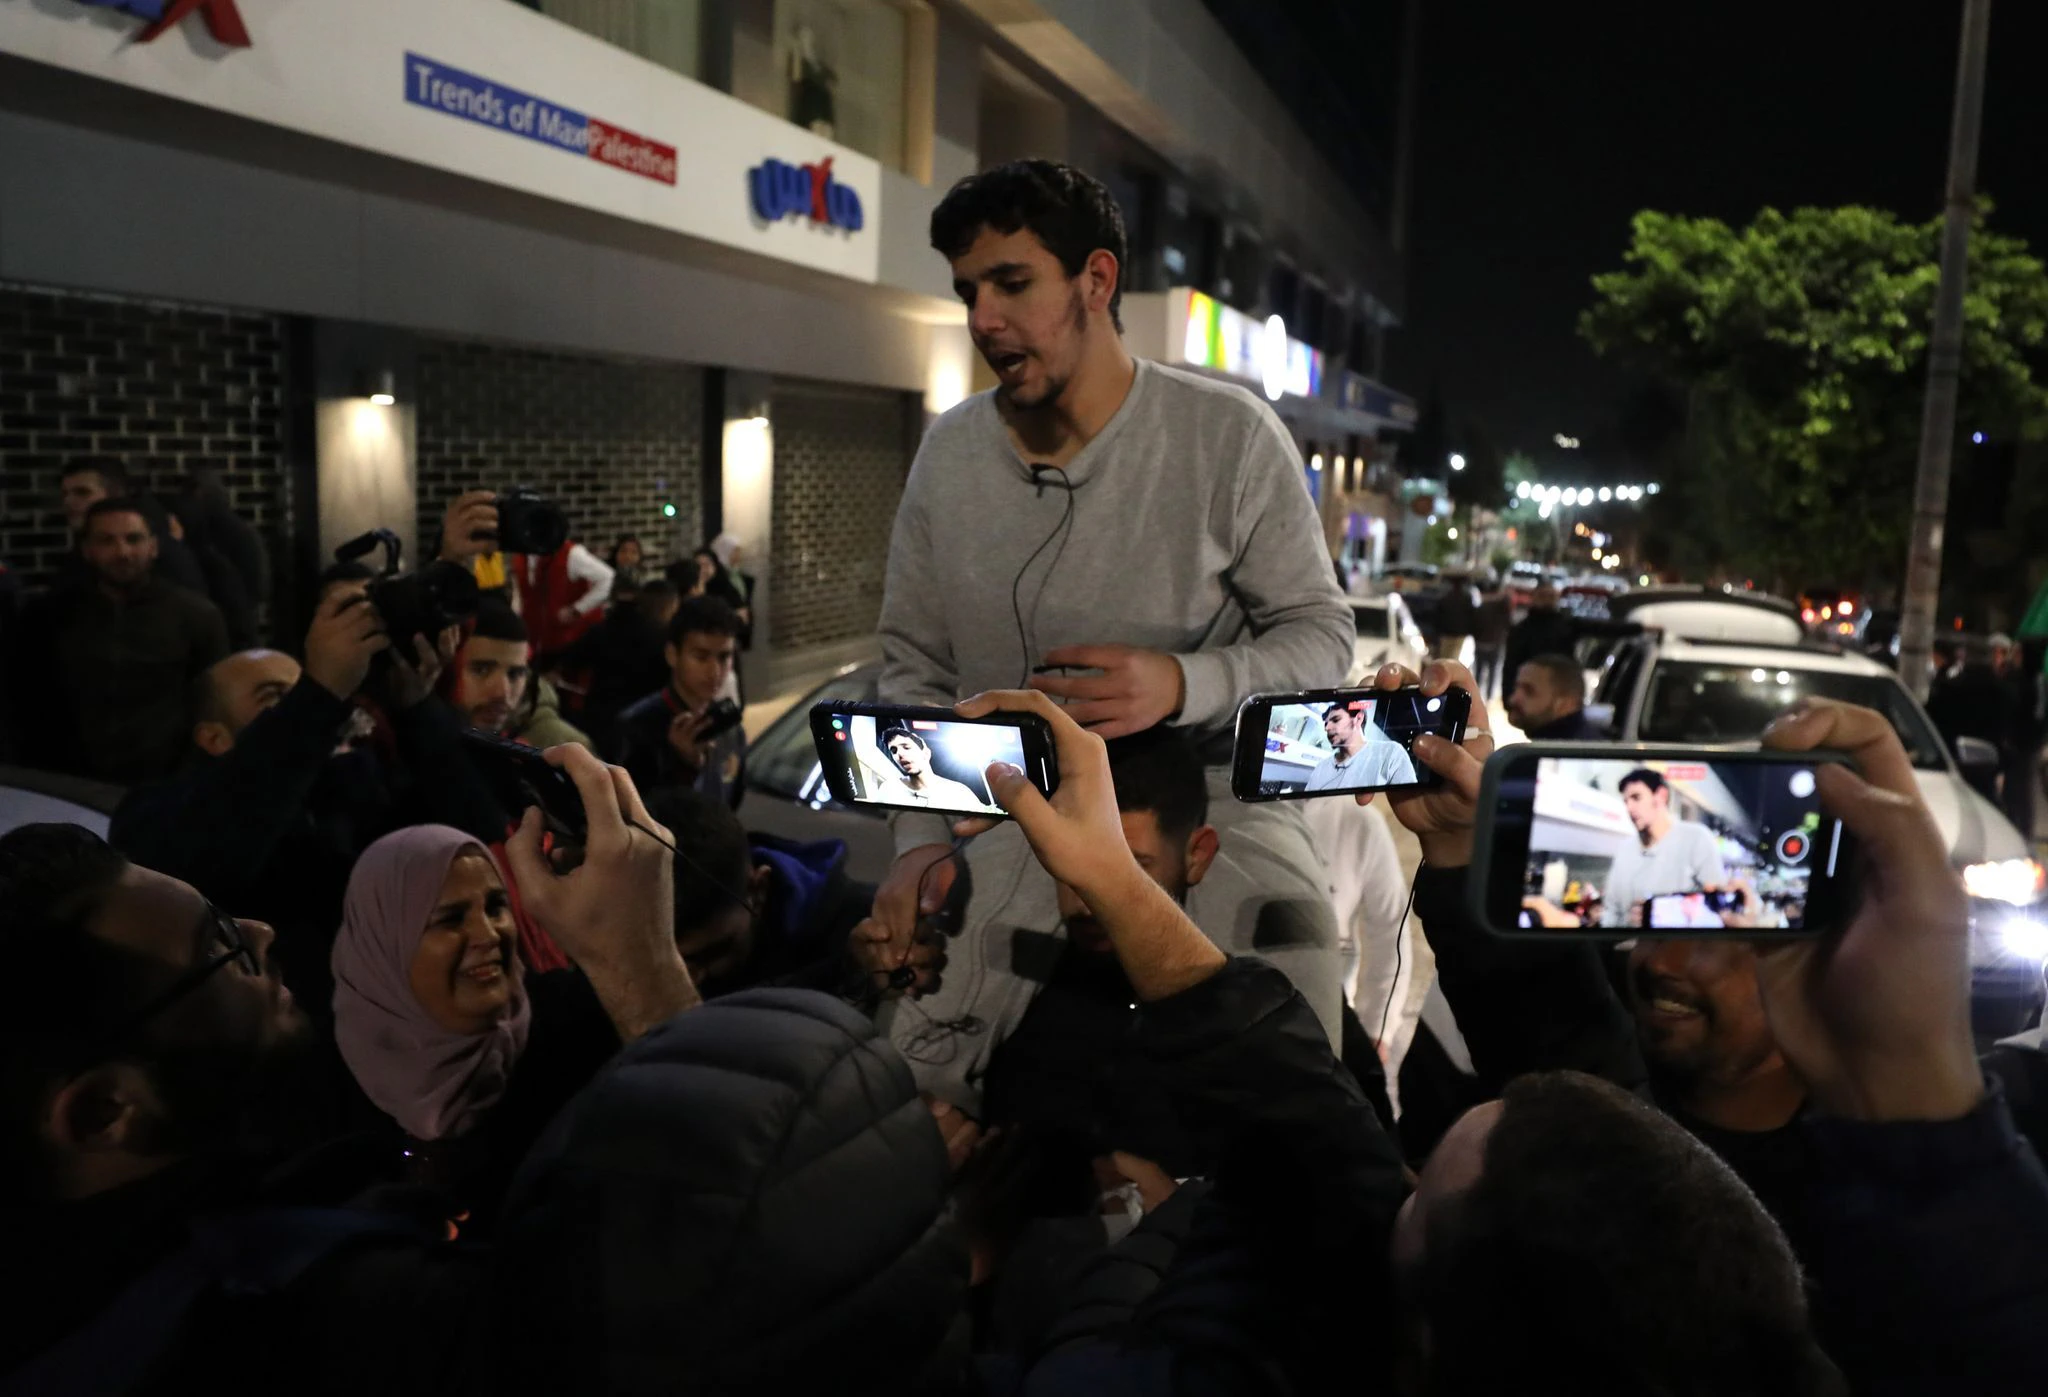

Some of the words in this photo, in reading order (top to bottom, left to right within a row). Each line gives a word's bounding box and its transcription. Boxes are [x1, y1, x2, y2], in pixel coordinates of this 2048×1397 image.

[414, 63, 505, 126] Trends
[509, 101, 537, 133] of
[589, 123, 675, 180] Palestine
